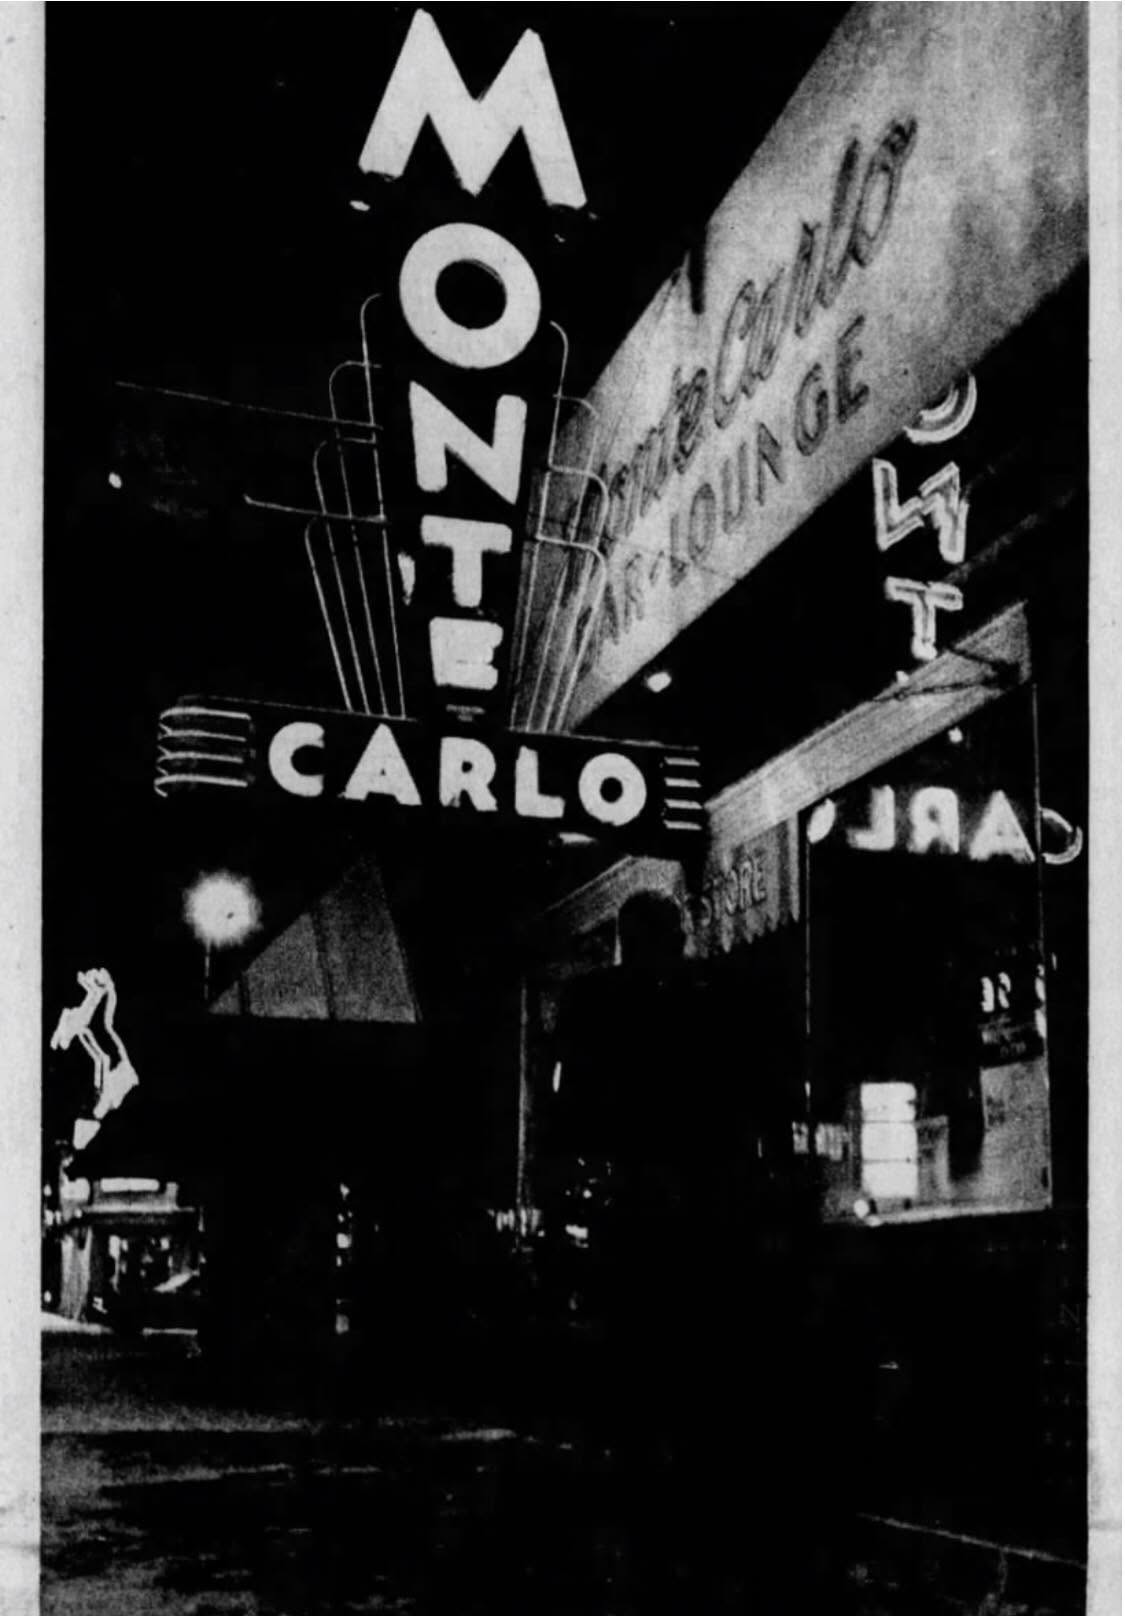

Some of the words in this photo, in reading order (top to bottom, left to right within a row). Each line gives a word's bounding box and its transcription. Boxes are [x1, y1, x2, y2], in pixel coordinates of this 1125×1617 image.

[358, 8, 587, 691] MONTE
[712, 117, 917, 430] Carlo
[268, 721, 647, 826] CARLO
